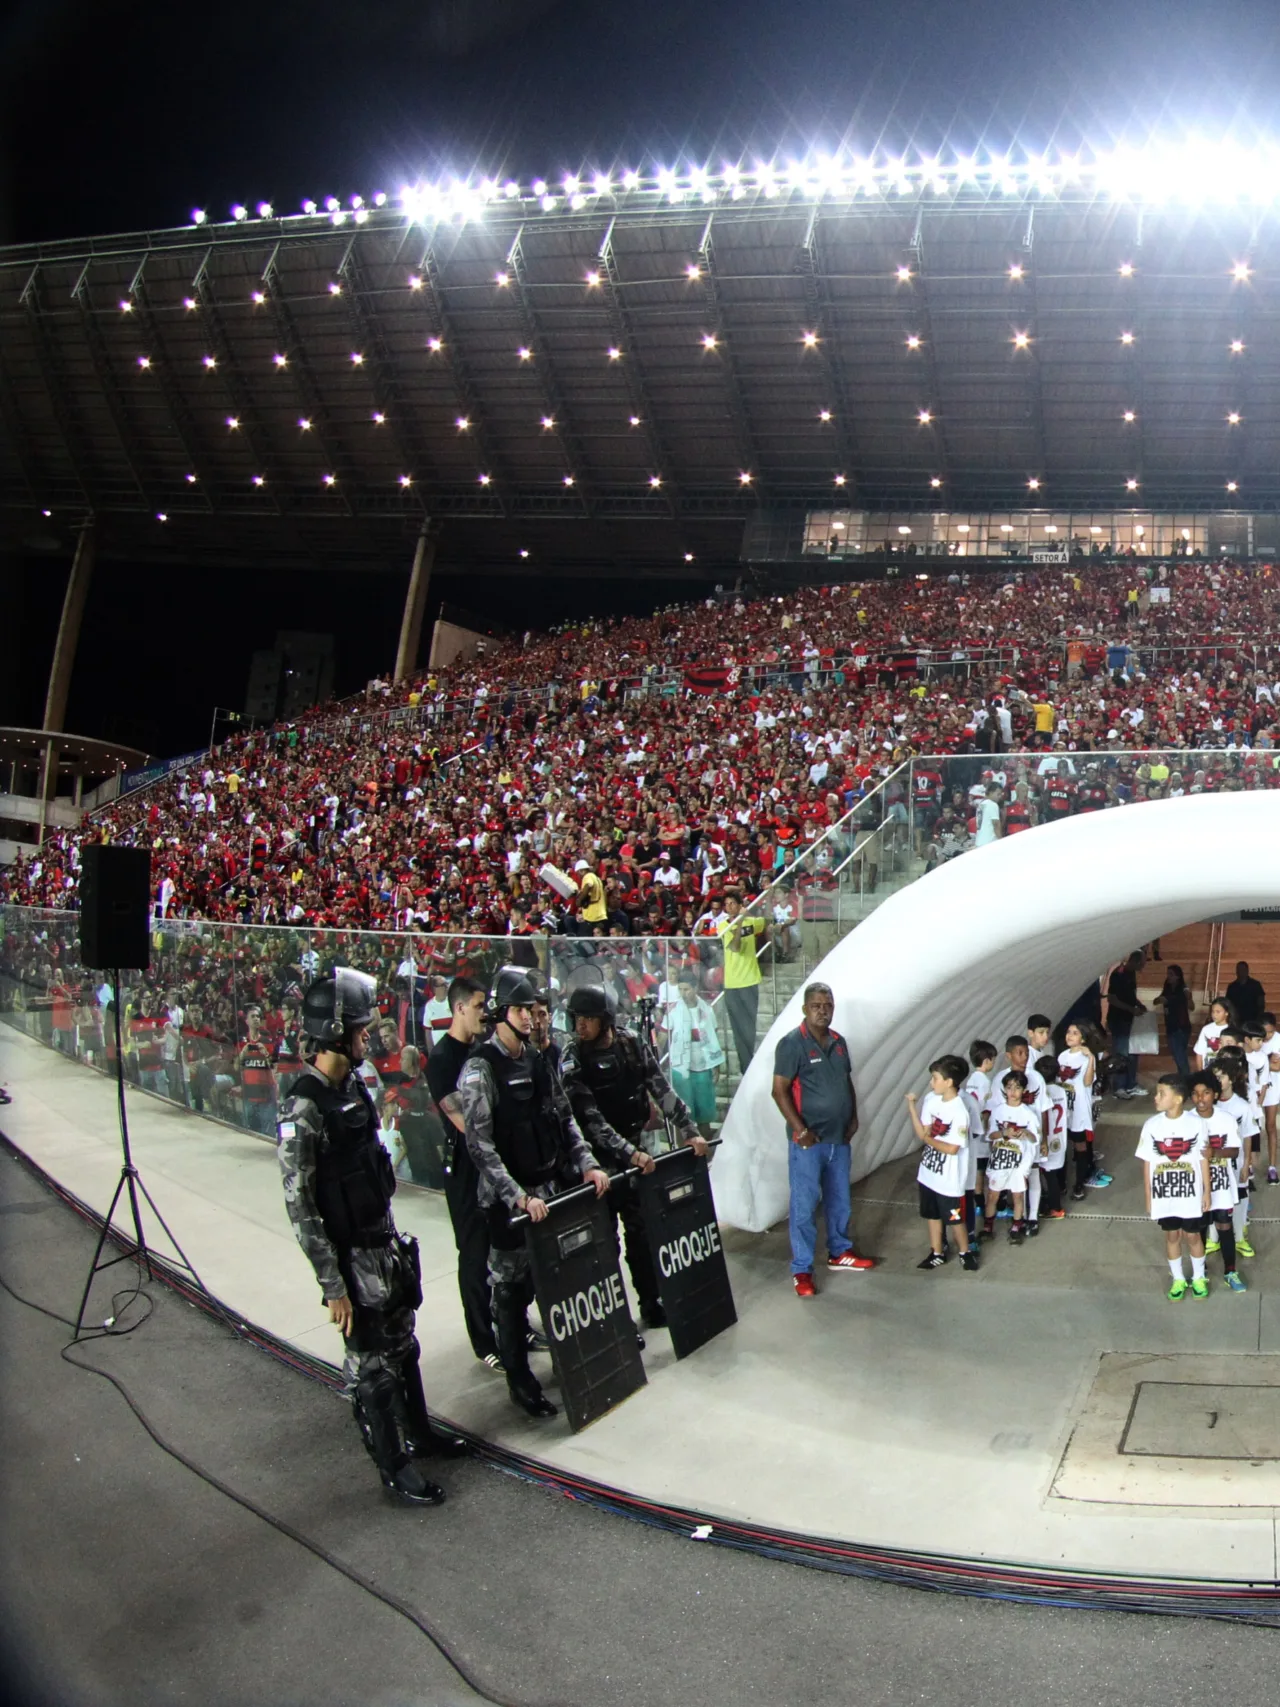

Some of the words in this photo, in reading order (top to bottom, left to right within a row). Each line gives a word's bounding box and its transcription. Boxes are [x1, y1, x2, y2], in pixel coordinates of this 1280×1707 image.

[1034, 553, 1059, 562] SETOR
[1061, 552, 1067, 562] A
[1152, 1184, 1196, 1199] NEGRA
[659, 1221, 721, 1278] CHOQUE
[550, 1272, 625, 1342] CHOQUE
